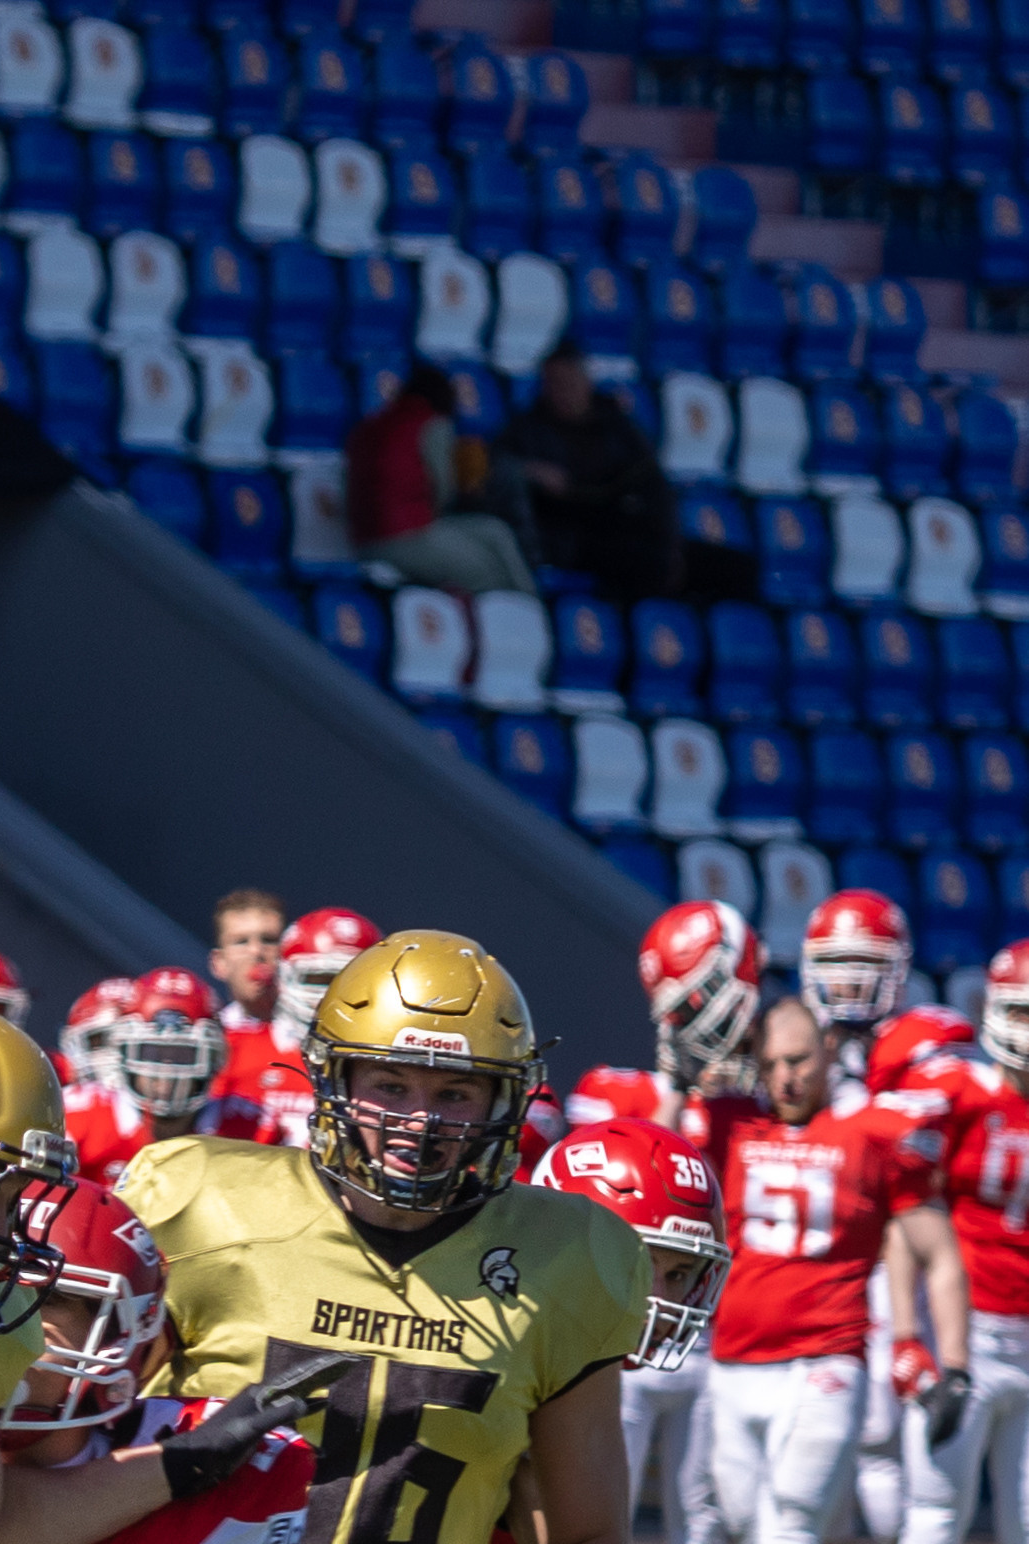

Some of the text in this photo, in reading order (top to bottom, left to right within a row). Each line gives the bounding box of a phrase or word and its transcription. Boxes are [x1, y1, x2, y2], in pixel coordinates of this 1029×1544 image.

[405, 1033, 464, 1051] Riddell
[668, 1152, 709, 1193] 39
[311, 1298, 467, 1354] SPARTANS
